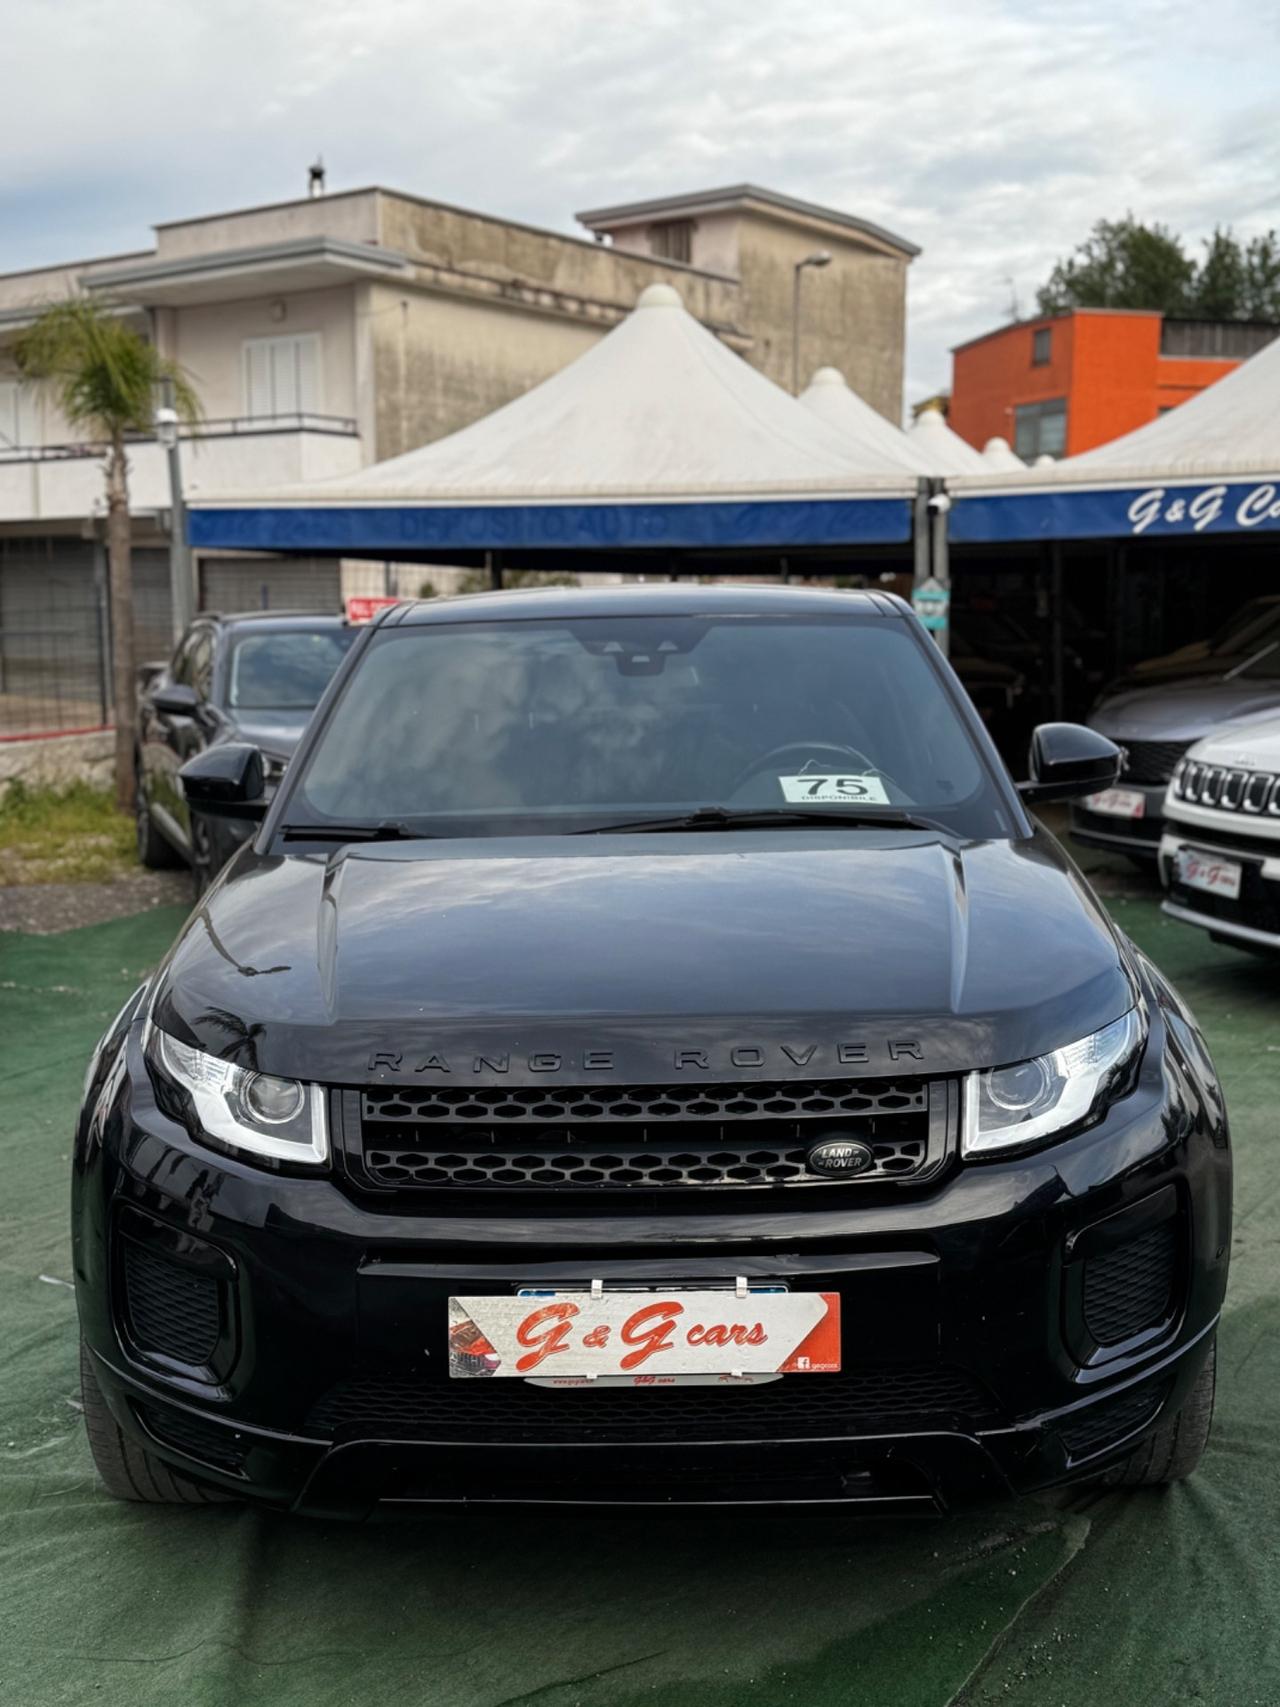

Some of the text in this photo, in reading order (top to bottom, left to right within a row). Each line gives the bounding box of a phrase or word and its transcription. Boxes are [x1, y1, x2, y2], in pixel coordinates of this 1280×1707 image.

[797, 778, 868, 796] 75
[367, 1040, 925, 1073] RANGE ROVER
[821, 1148, 852, 1158] LAND
[825, 1157, 862, 1168] ROVER
[515, 1302, 580, 1372] G
[620, 1301, 684, 1371] G
[686, 1321, 769, 1347] cars
